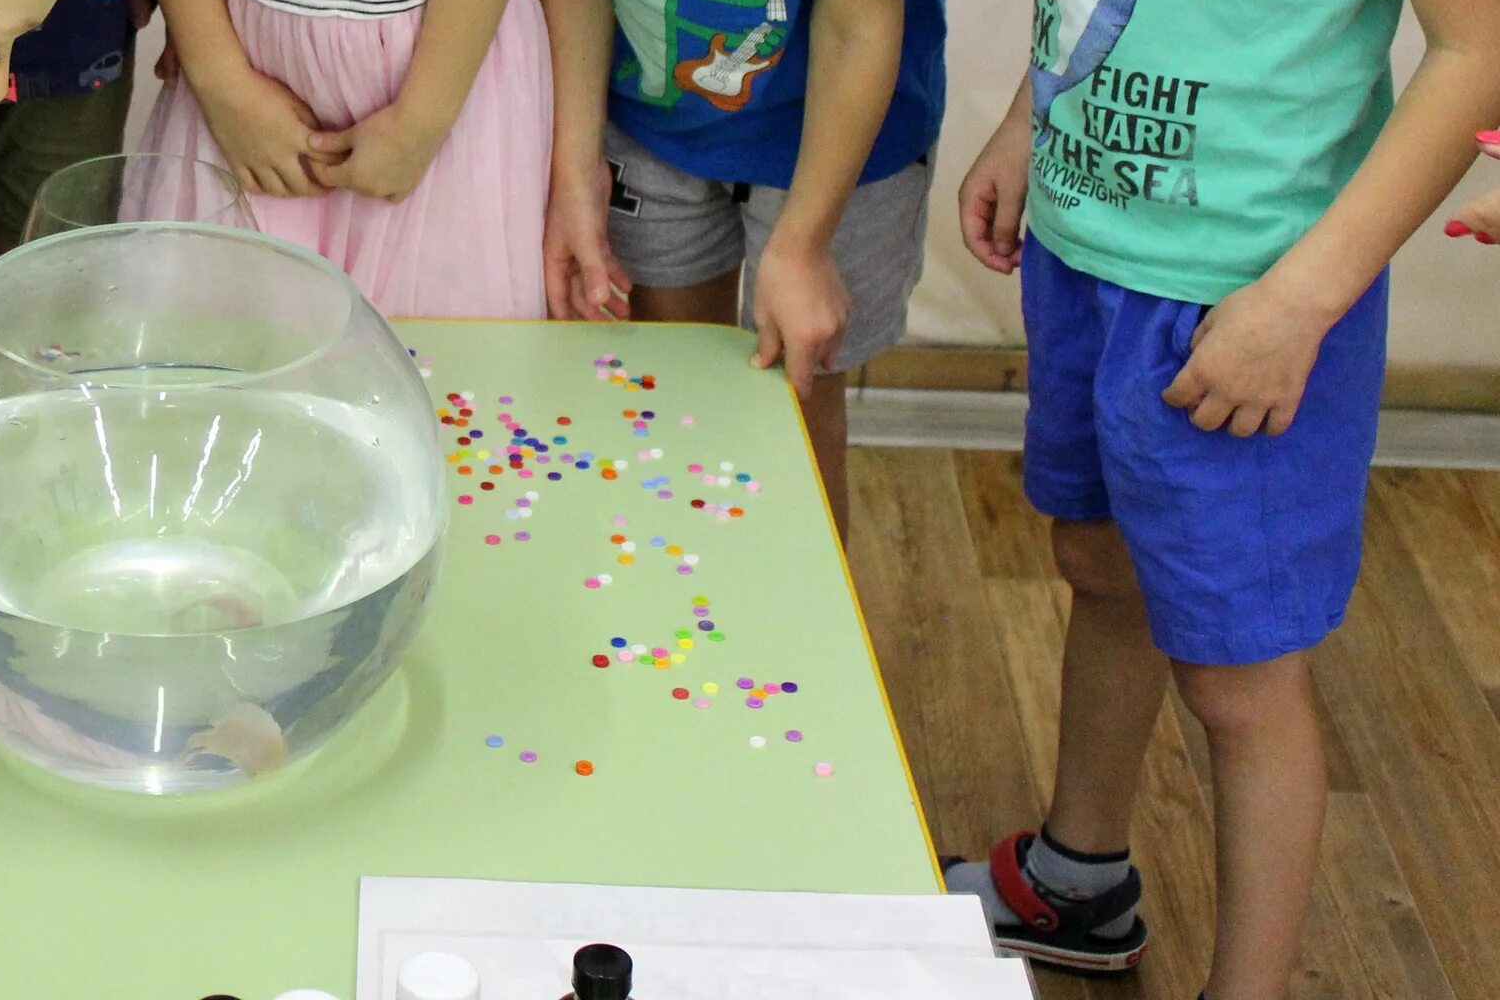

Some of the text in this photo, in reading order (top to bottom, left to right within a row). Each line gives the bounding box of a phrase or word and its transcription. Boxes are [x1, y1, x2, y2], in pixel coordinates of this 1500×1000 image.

[1090, 64, 1209, 116] FIGHT
[1083, 100, 1196, 161] HARD
[1032, 153, 1130, 210] AVYWEIGHT
[1049, 124, 1198, 207] THE SEA
